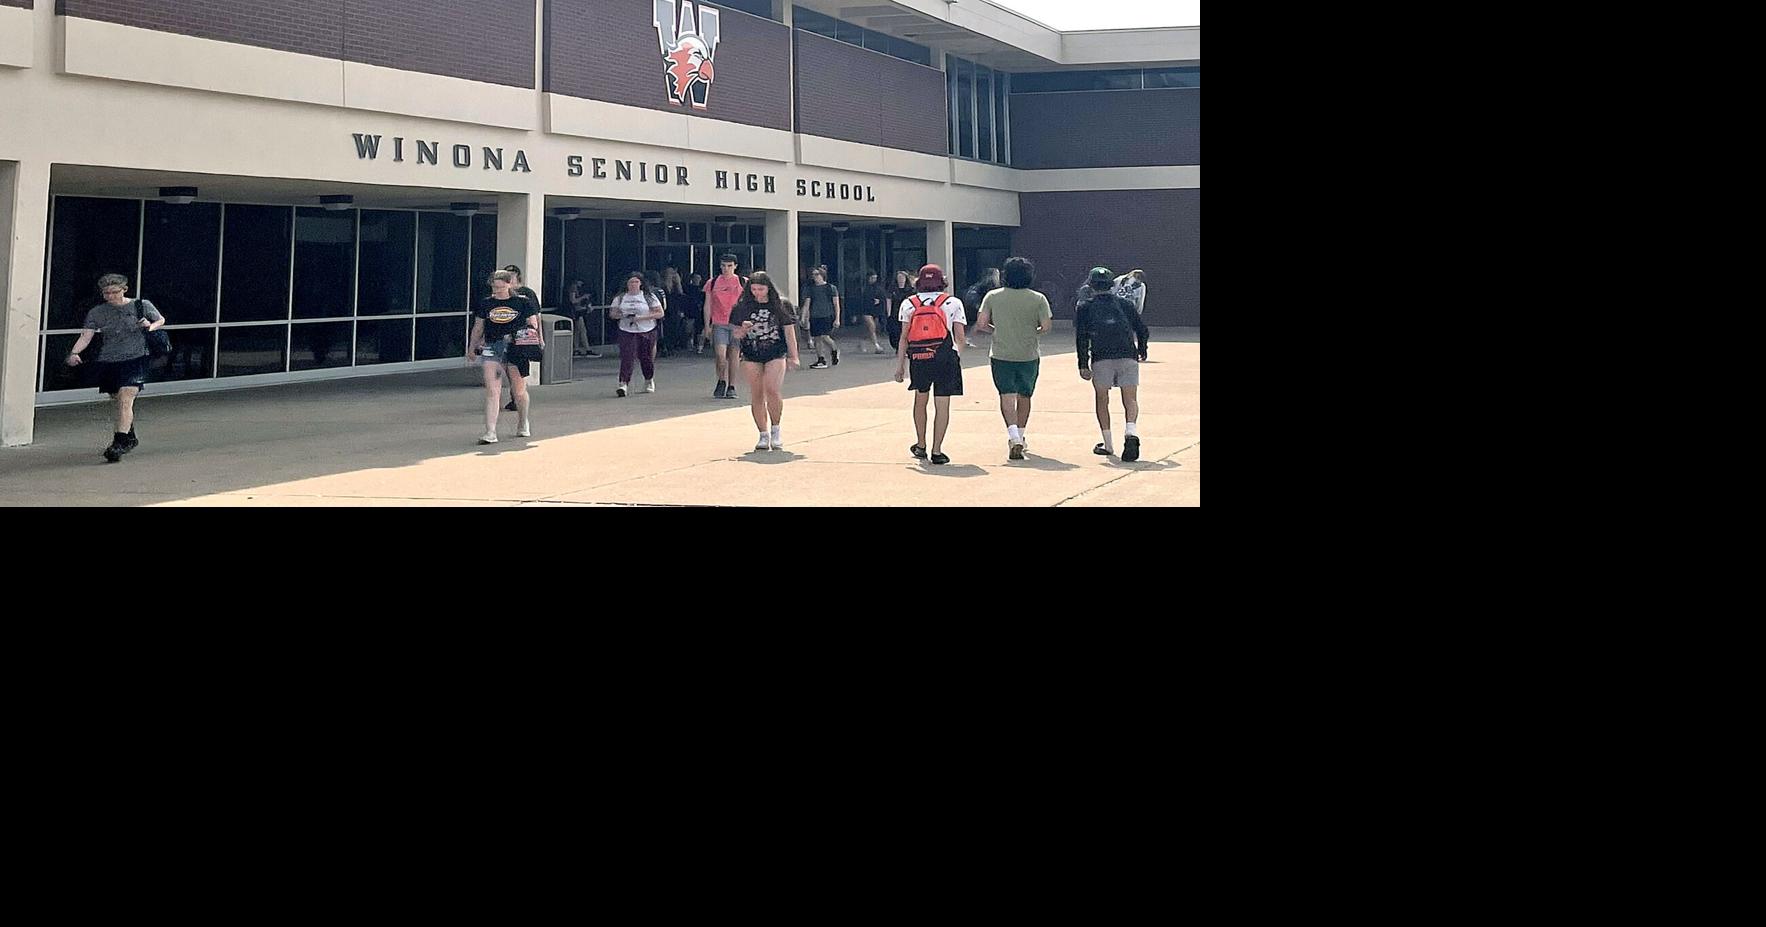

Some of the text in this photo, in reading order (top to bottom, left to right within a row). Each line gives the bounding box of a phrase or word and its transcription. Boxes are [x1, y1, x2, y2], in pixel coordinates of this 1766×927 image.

[653, 0, 720, 109] W
[352, 133, 875, 202] WINONA SENIOR HIGH SCHOOL
